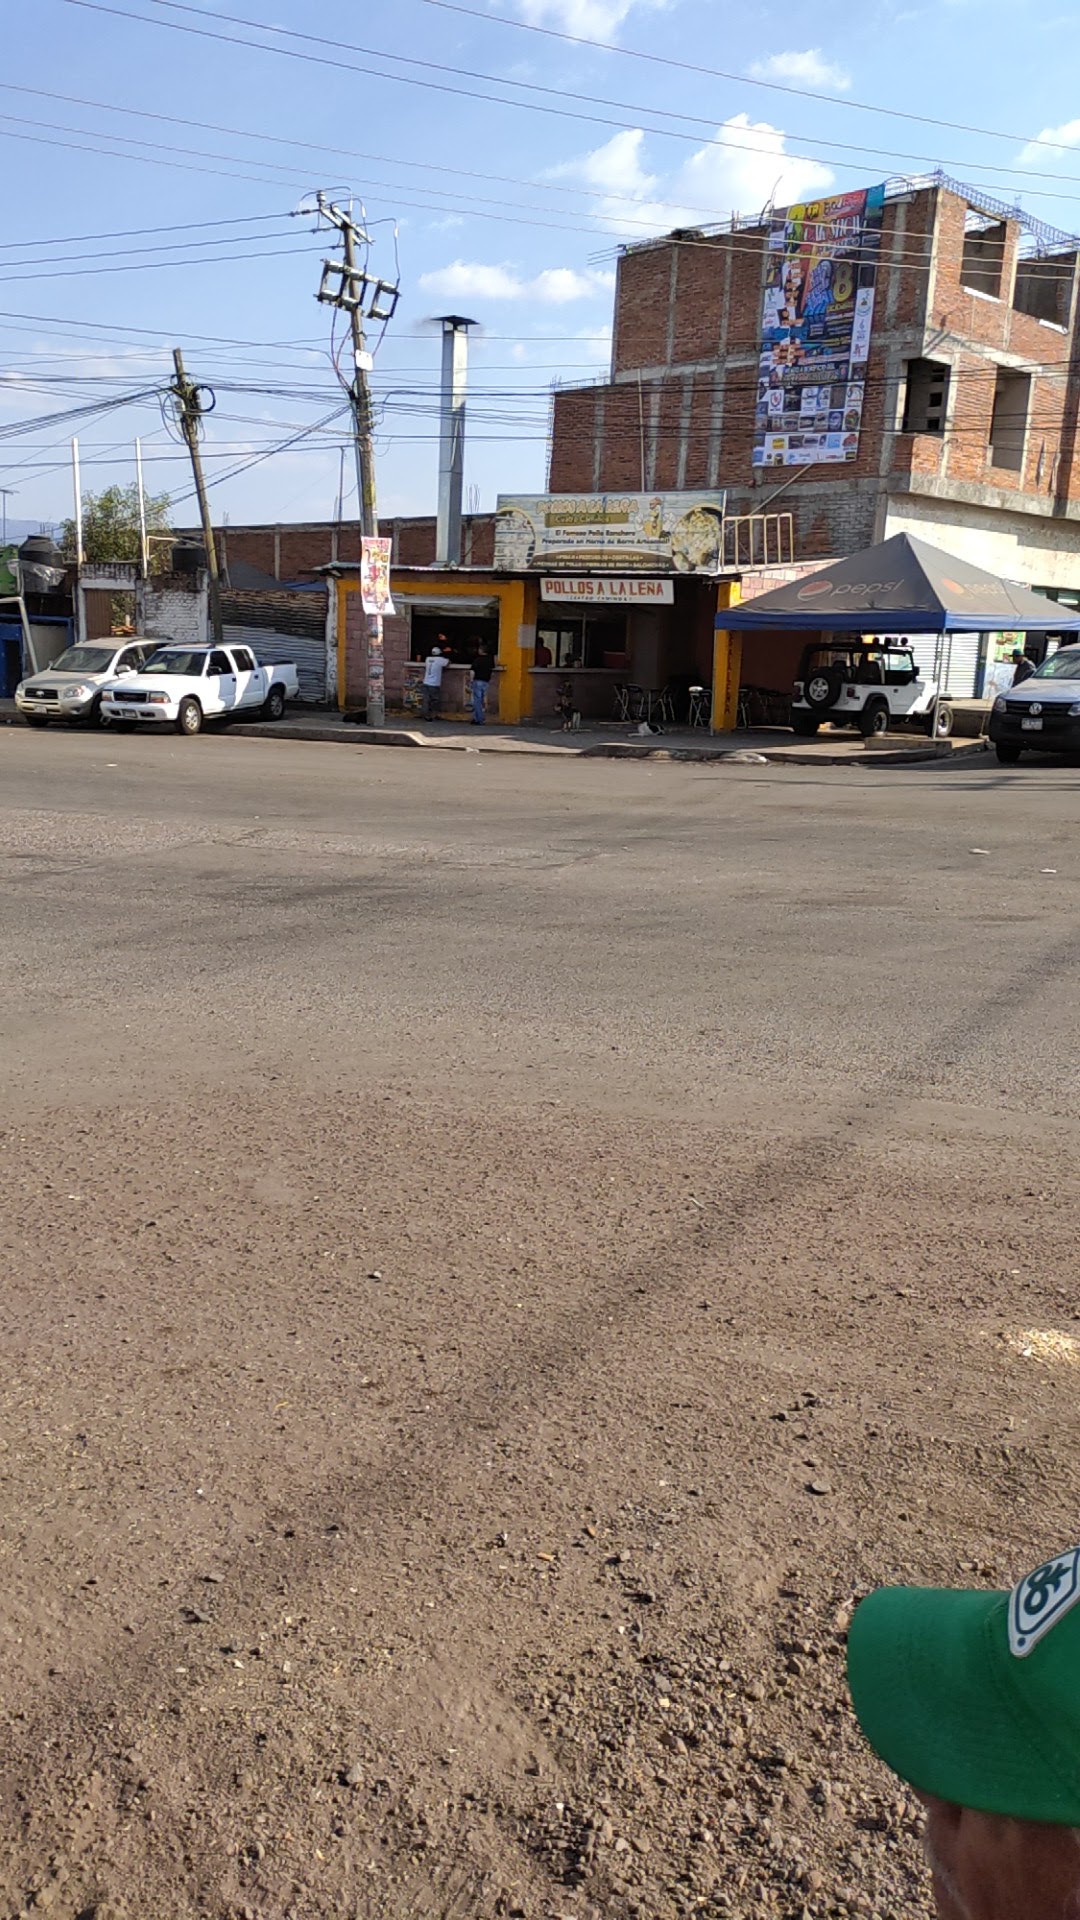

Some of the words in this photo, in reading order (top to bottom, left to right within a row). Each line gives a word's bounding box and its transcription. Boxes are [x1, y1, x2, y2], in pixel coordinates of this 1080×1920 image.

[577, 499, 588, 514] A
[545, 580, 594, 595] POLLOS
[596, 581, 605, 595] A
[609, 581, 627, 596] LA
[629, 581, 664, 597] LEÑA
[830, 579, 905, 597] pepsi
